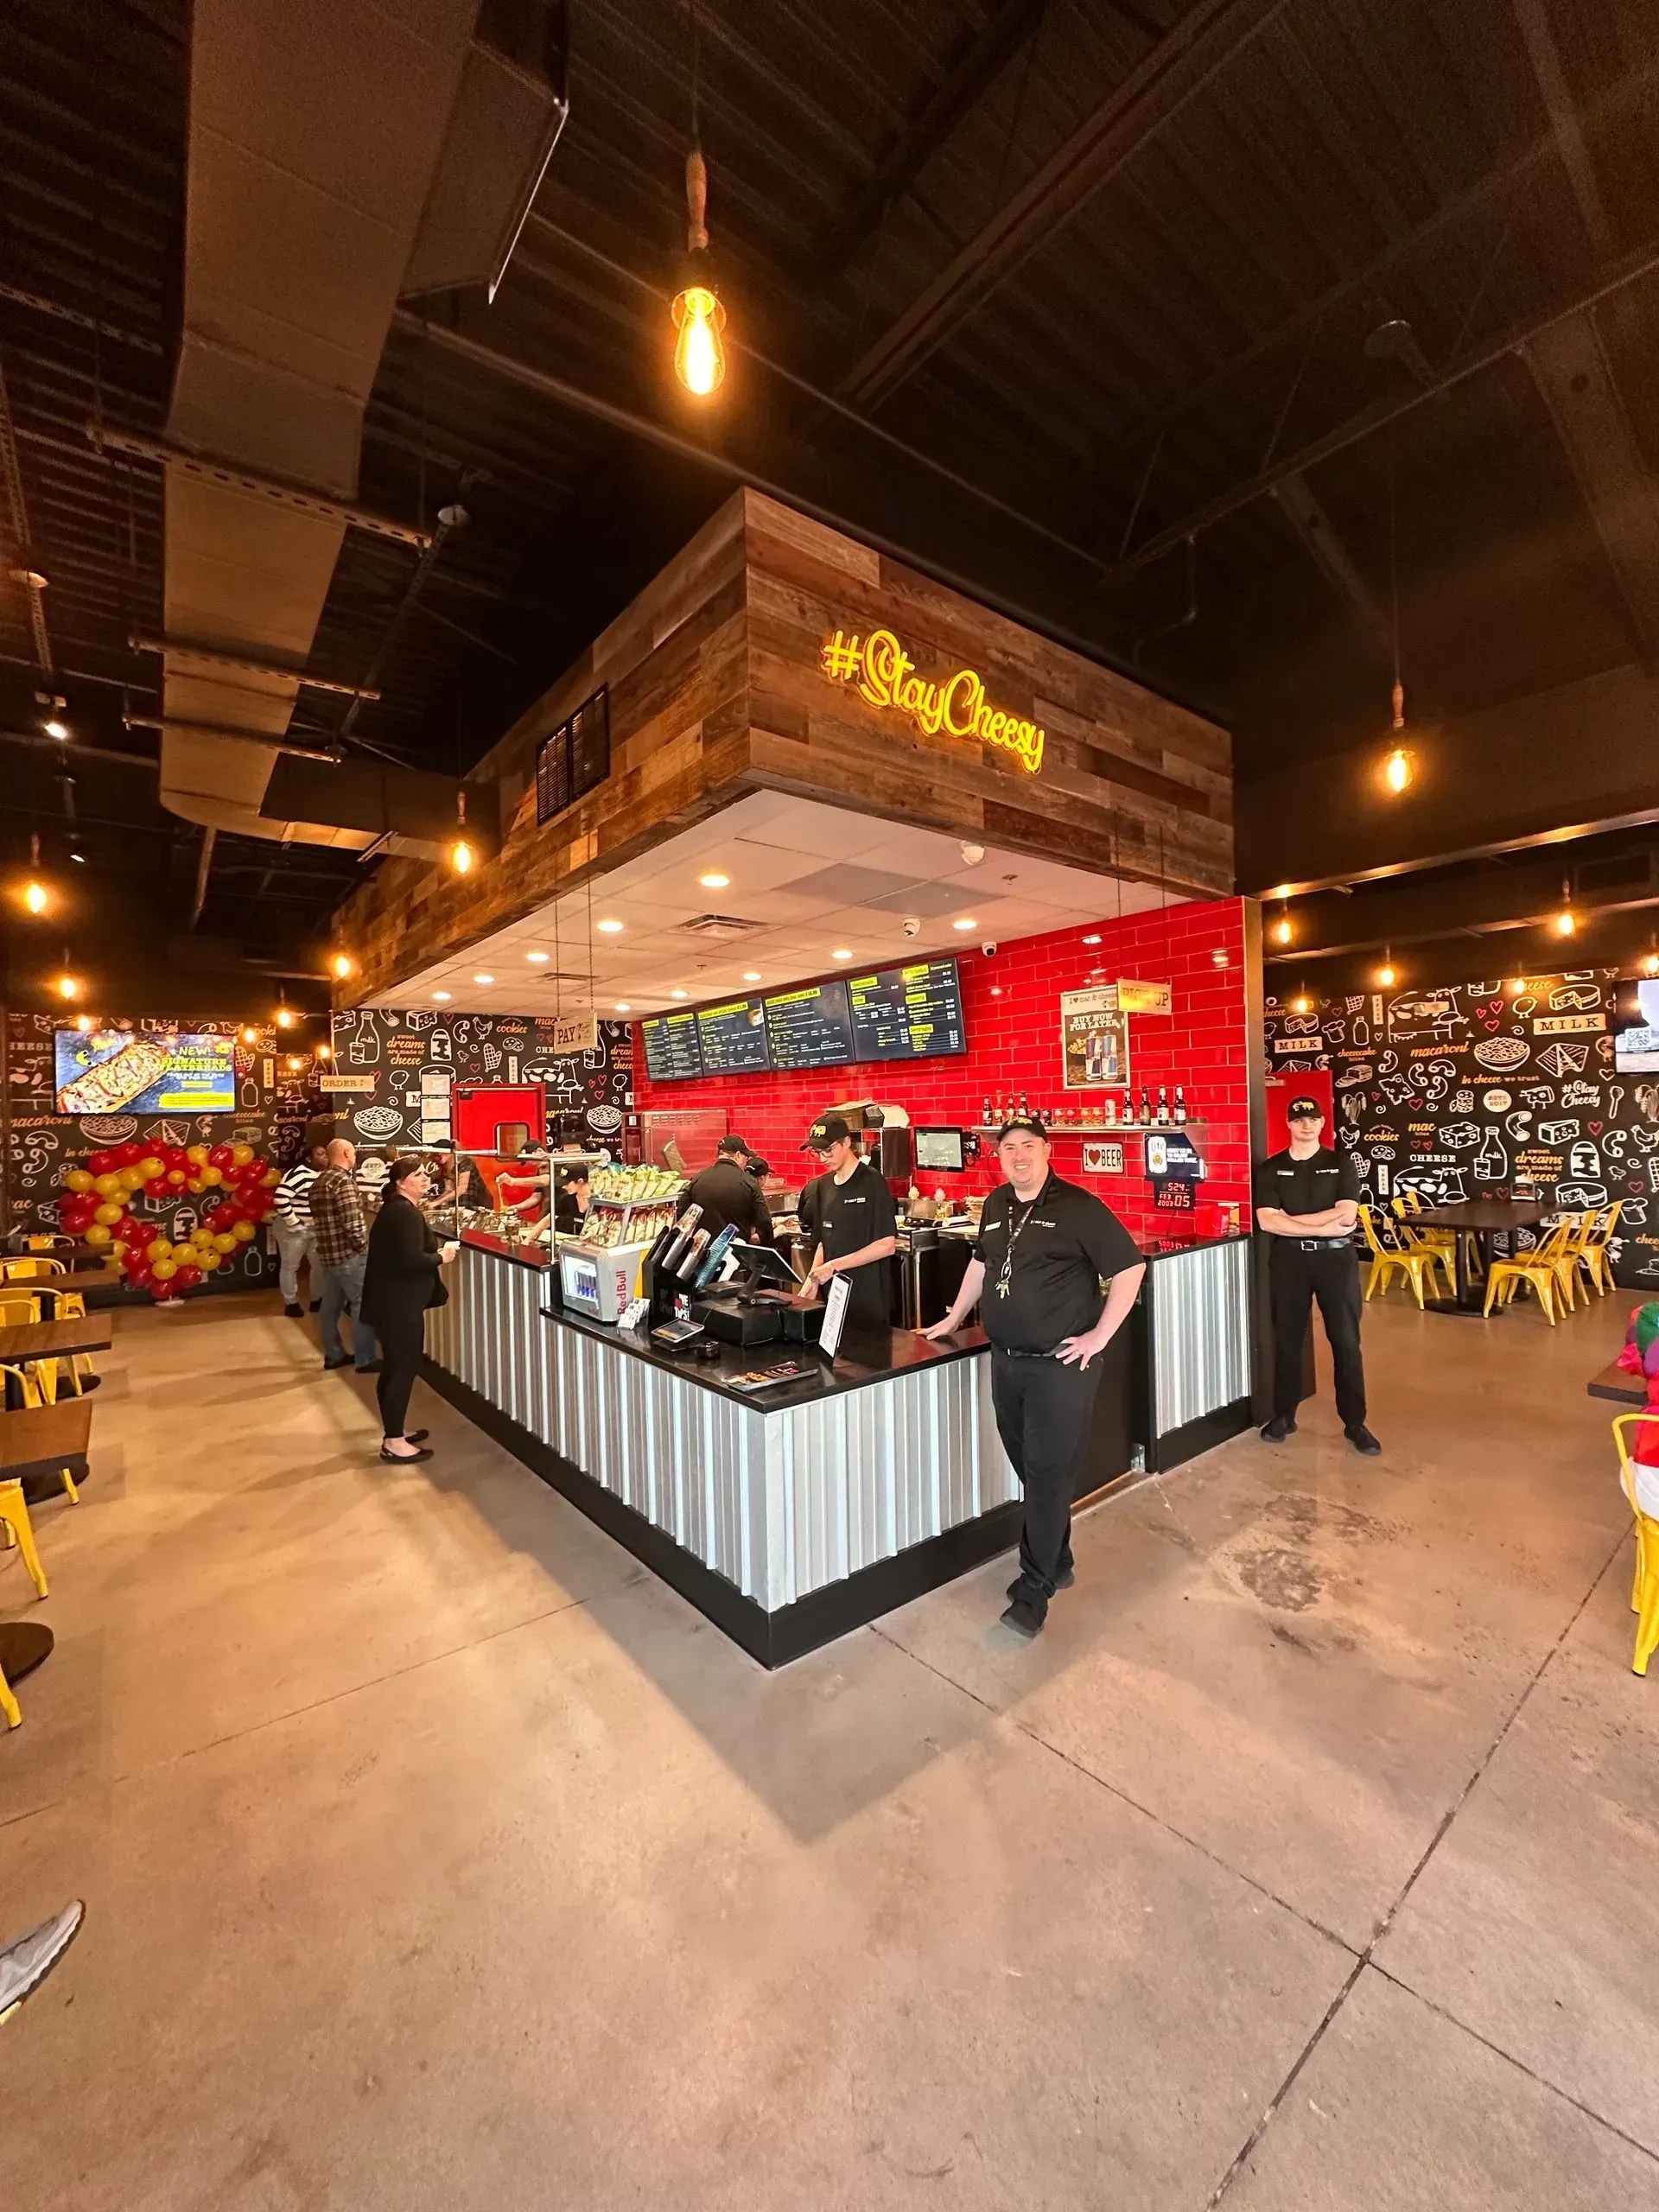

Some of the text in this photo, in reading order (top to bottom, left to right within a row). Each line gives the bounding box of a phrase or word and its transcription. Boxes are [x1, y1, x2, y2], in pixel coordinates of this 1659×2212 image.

[823, 629, 1046, 772] #StayCheesy
[1264, 1007, 1287, 1018] heese
[1072, 1013, 1114, 1024] BUY NOW
[1540, 1017, 1600, 1031] MILK
[496, 1022, 528, 1033] cookies
[1069, 1022, 1088, 1032] FOR
[557, 1026, 576, 1046] PAY
[386, 1036, 426, 1049] dreams
[1279, 1039, 1319, 1050] MILK
[1410, 1041, 1470, 1058] macaroni
[391, 1053, 423, 1065] cheese
[322, 1079, 357, 1088] ORDER
[1473, 1074, 1503, 1084] cheese
[1408, 1122, 1436, 1132] mac
[1364, 1130, 1400, 1141] cookies
[1084, 1147, 1122, 1167] I BEER
[1409, 1154, 1457, 1163] CHEESE
[1515, 1151, 1564, 1164] dreams
[1174, 1195, 1191, 1208] 05
[616, 1270, 627, 1315] Red Bull
